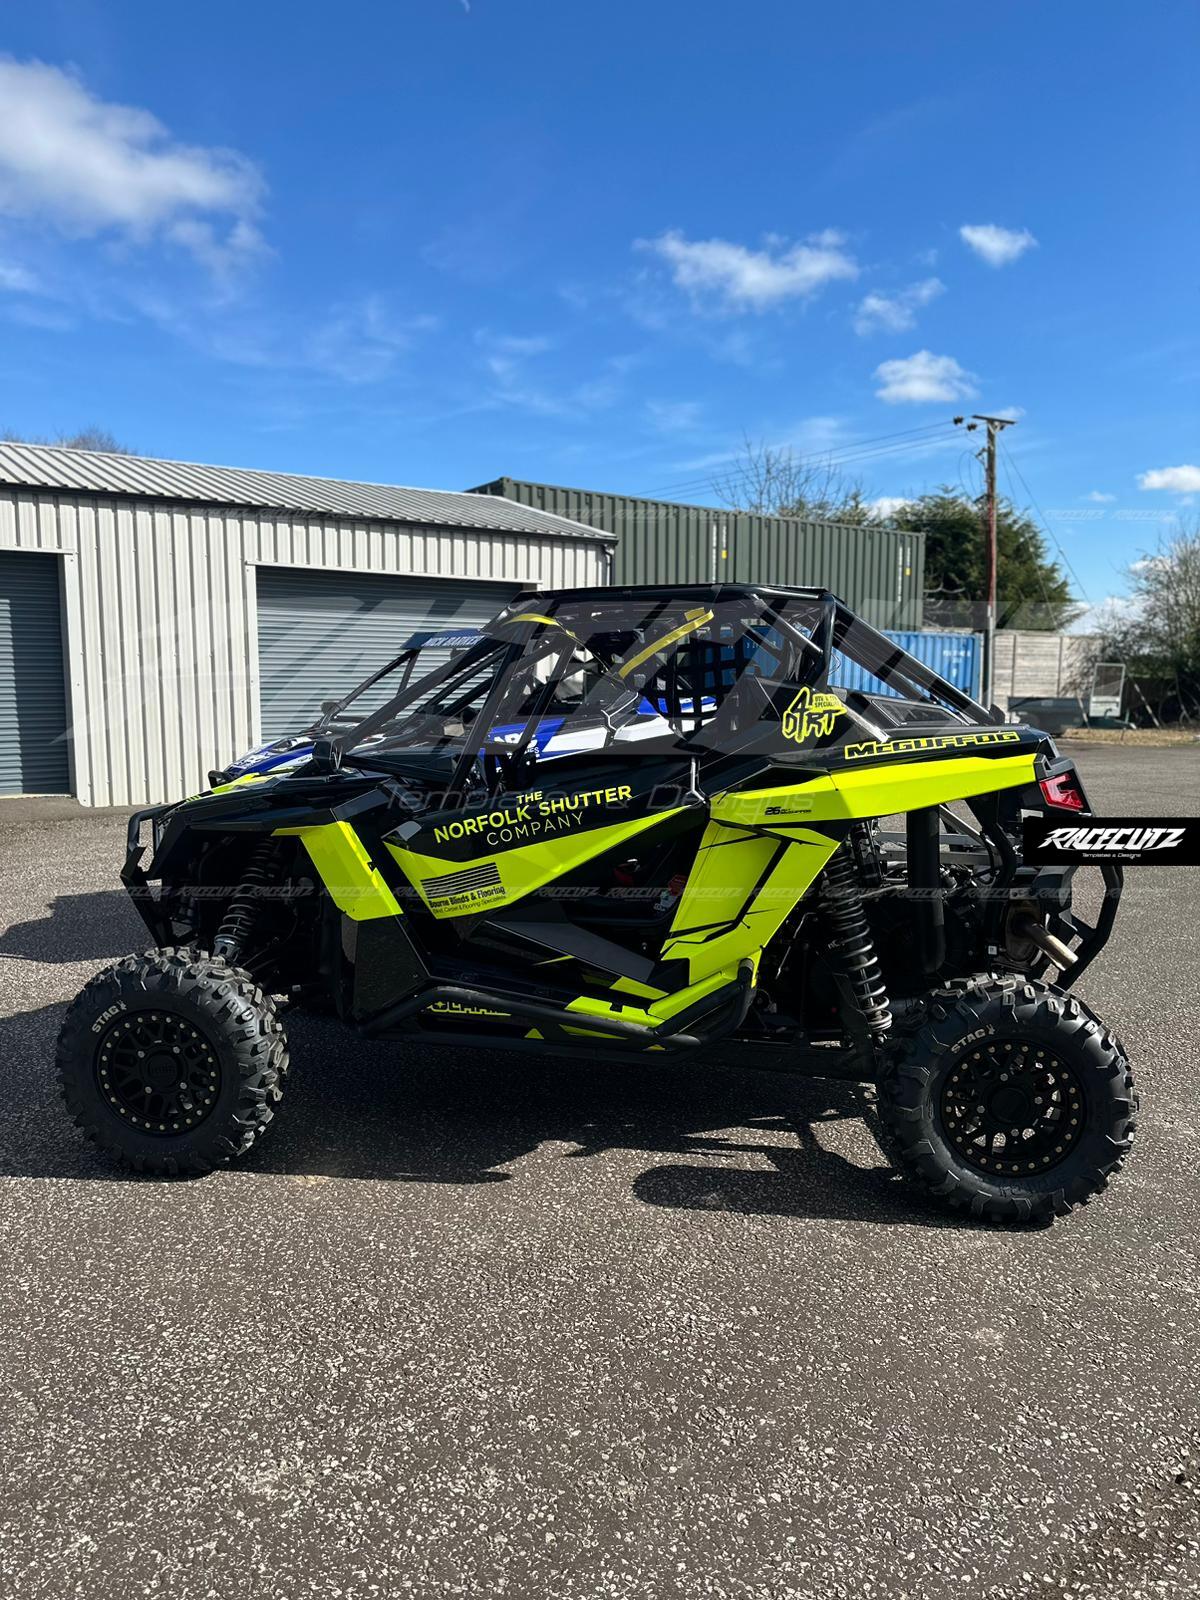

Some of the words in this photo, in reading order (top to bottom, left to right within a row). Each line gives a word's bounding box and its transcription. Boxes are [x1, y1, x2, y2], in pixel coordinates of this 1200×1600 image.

[516, 790, 543, 805] THE
[434, 804, 531, 844] NORFOLK
[538, 785, 633, 816] SHUTTER
[486, 811, 584, 846] COMPANY
[477, 886, 506, 899] Flooring
[92, 1005, 120, 1033] STAG
[951, 1029, 986, 1054] STAG
